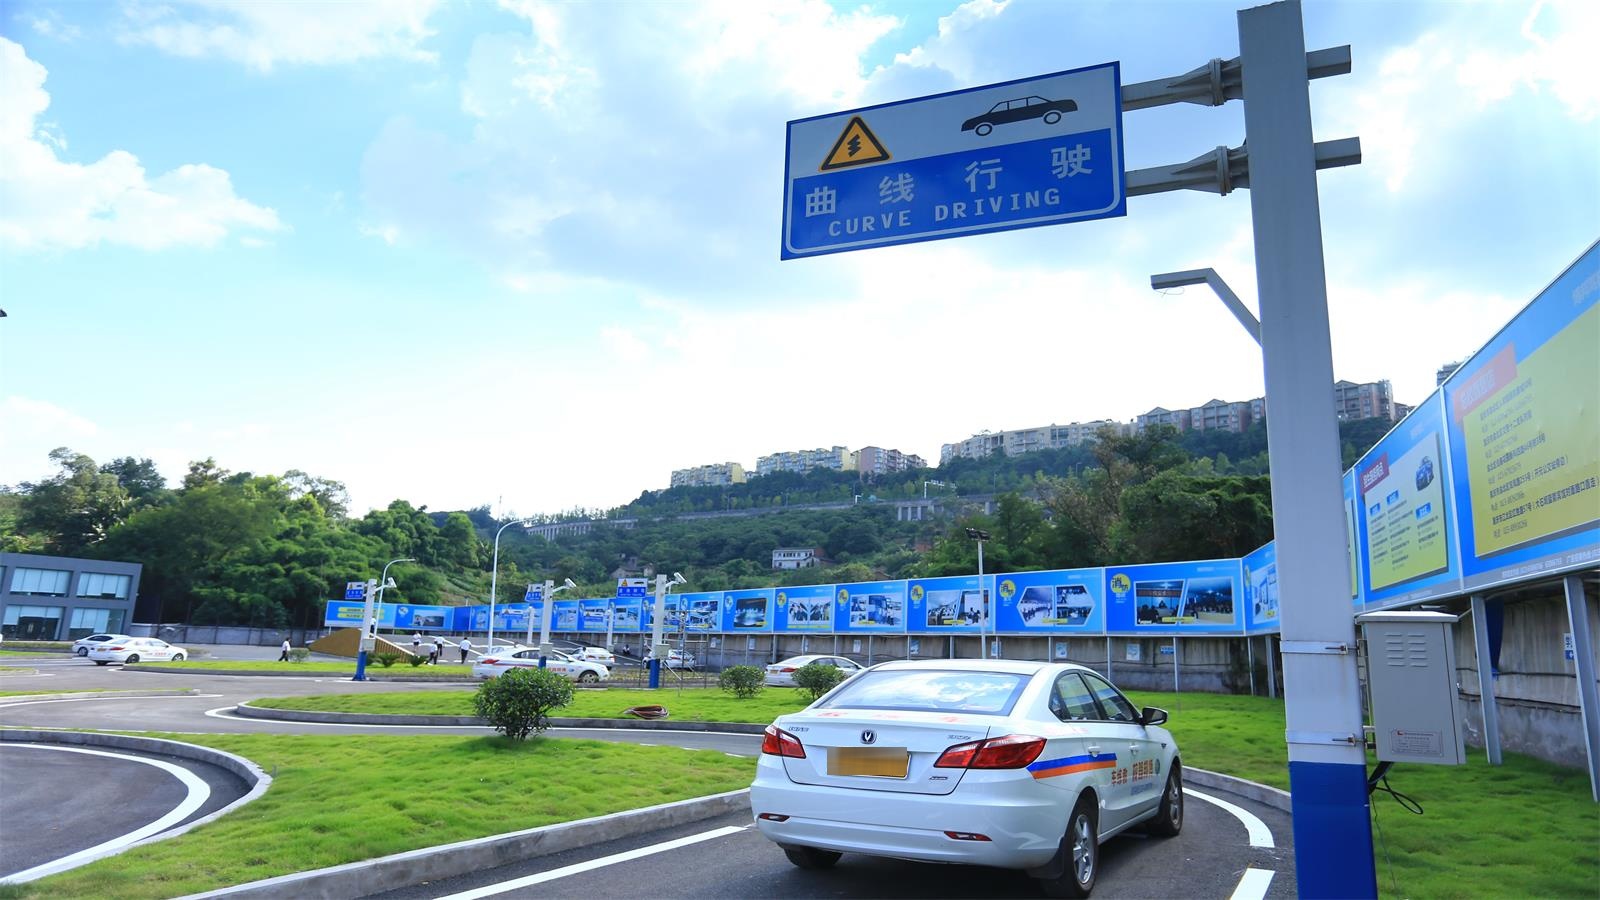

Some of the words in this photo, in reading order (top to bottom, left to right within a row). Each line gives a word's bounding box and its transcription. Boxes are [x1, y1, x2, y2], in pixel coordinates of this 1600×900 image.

[805, 144, 1093, 218] 曲线行驶
[828, 210, 912, 237] CURVE
[934, 188, 1061, 222] DRIVING
